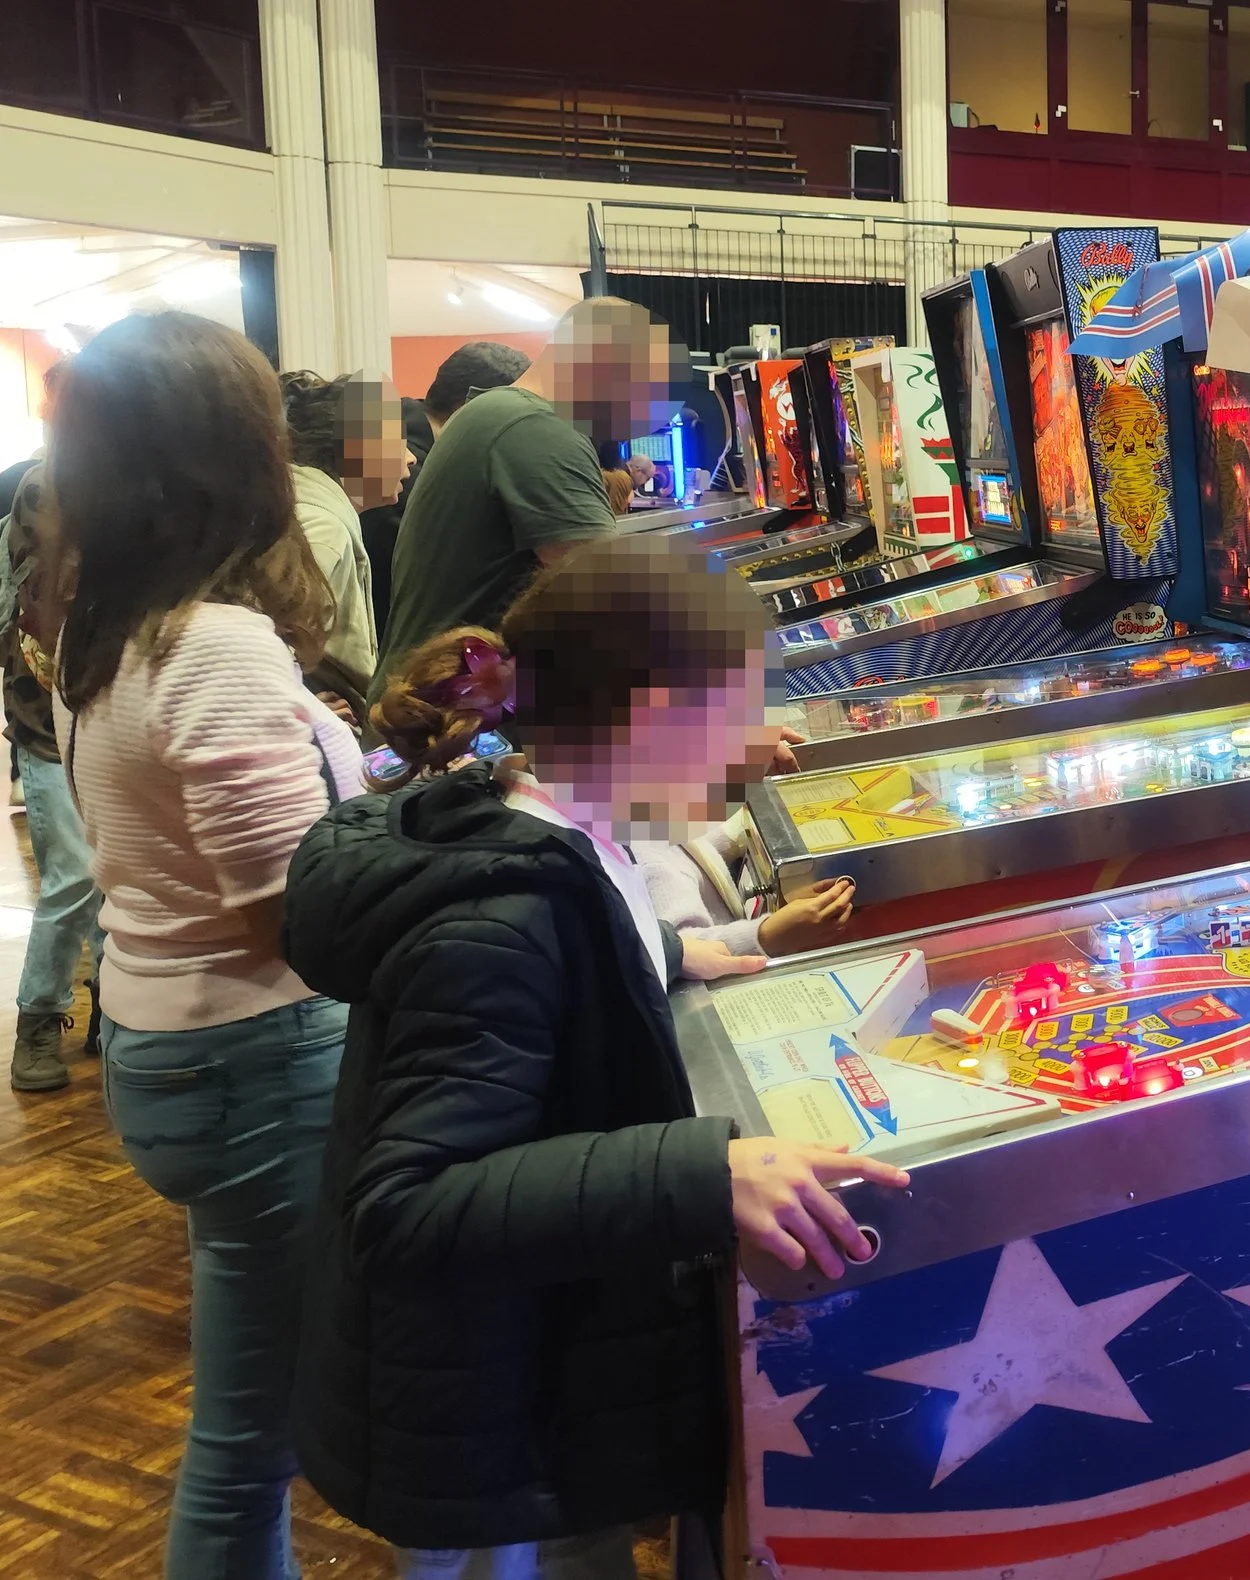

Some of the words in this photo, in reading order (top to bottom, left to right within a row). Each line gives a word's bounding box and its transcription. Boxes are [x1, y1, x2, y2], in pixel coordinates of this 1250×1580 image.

[1081, 241, 1134, 271] Bally
[1123, 613, 1131, 621] HE
[1145, 612, 1155, 620] SO
